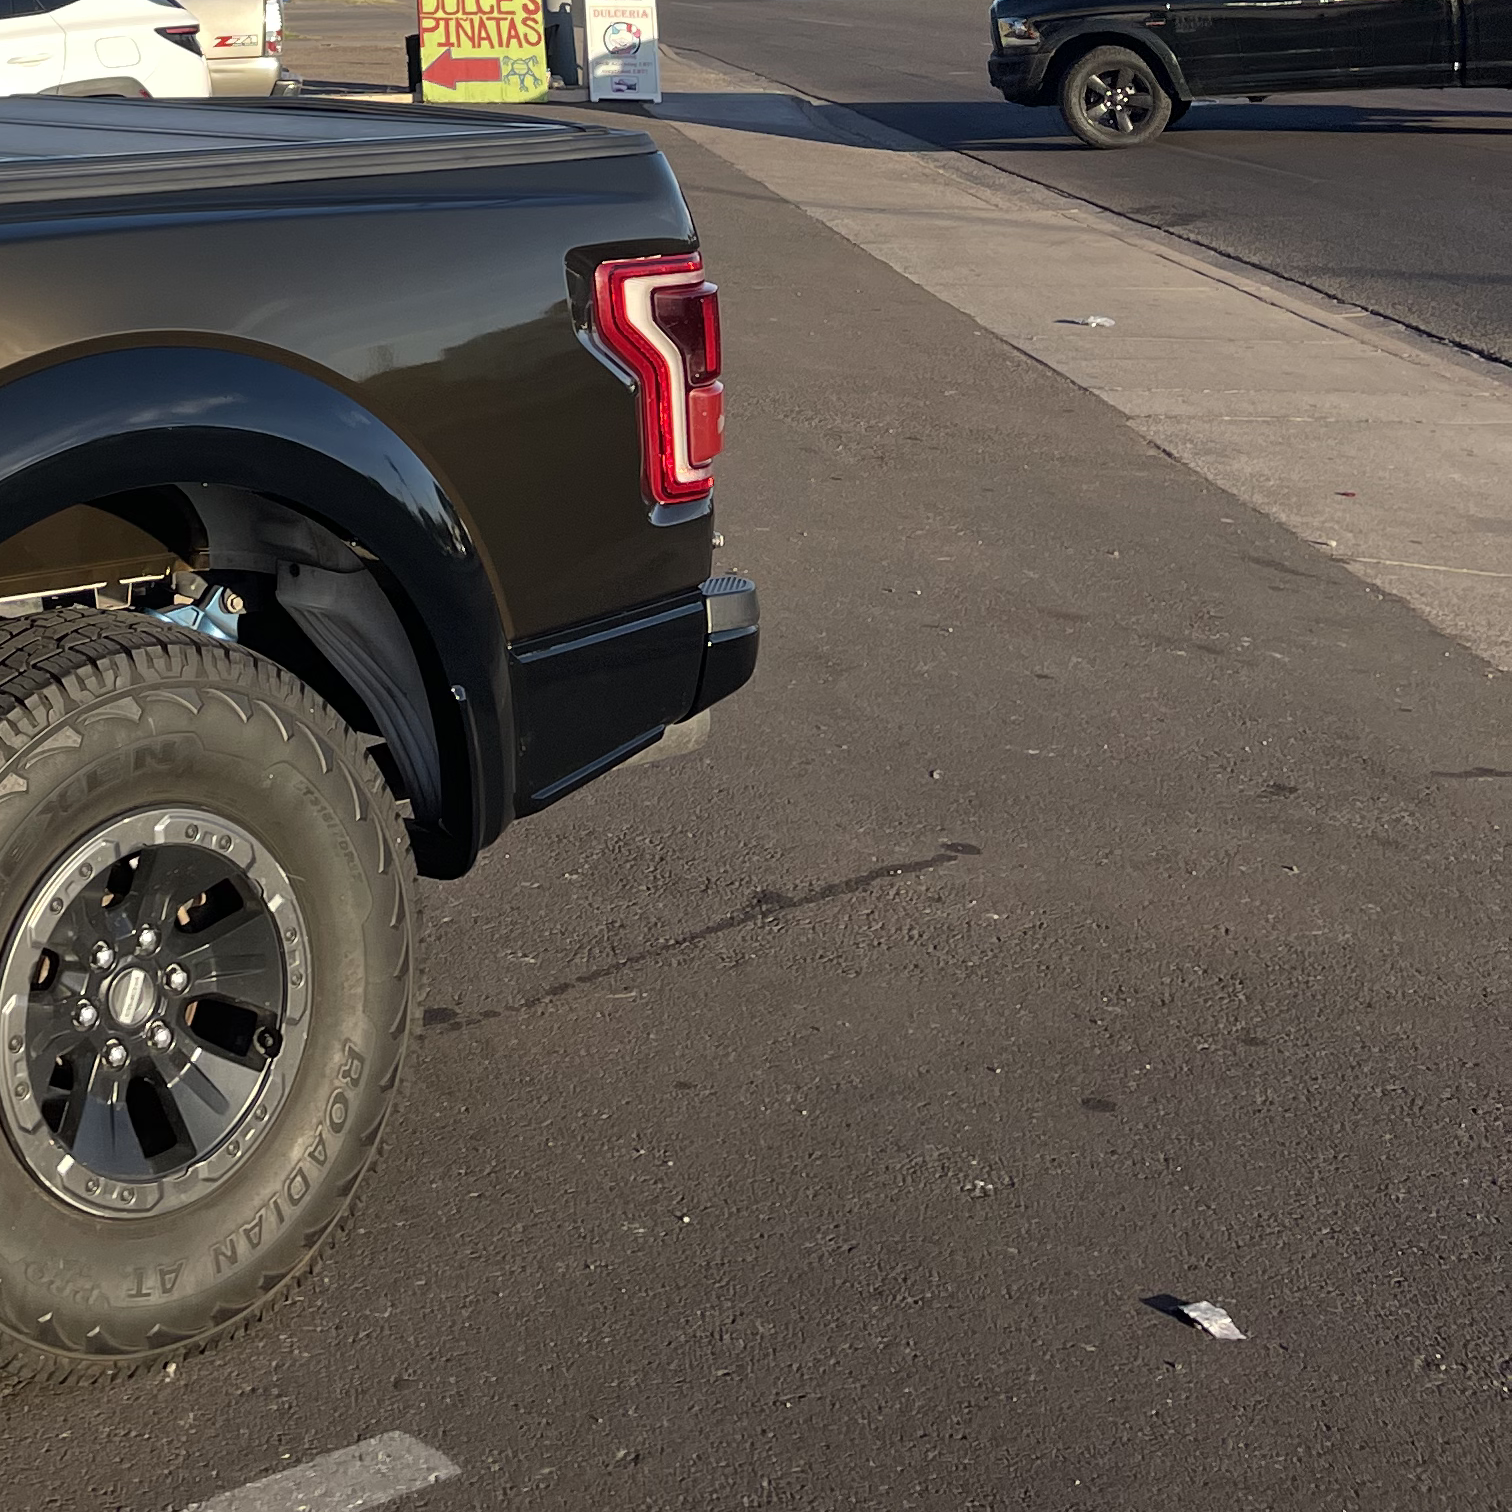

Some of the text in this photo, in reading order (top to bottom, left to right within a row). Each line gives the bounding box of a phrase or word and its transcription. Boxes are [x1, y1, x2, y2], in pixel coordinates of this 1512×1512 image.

[593, 9, 649, 18] DULCERIA
[213, 34, 258, 47] Z71
[420, 15, 543, 49] PIÑATAS
[211, 1038, 366, 1275] ROADIAN
[125, 1258, 188, 1299] AT
